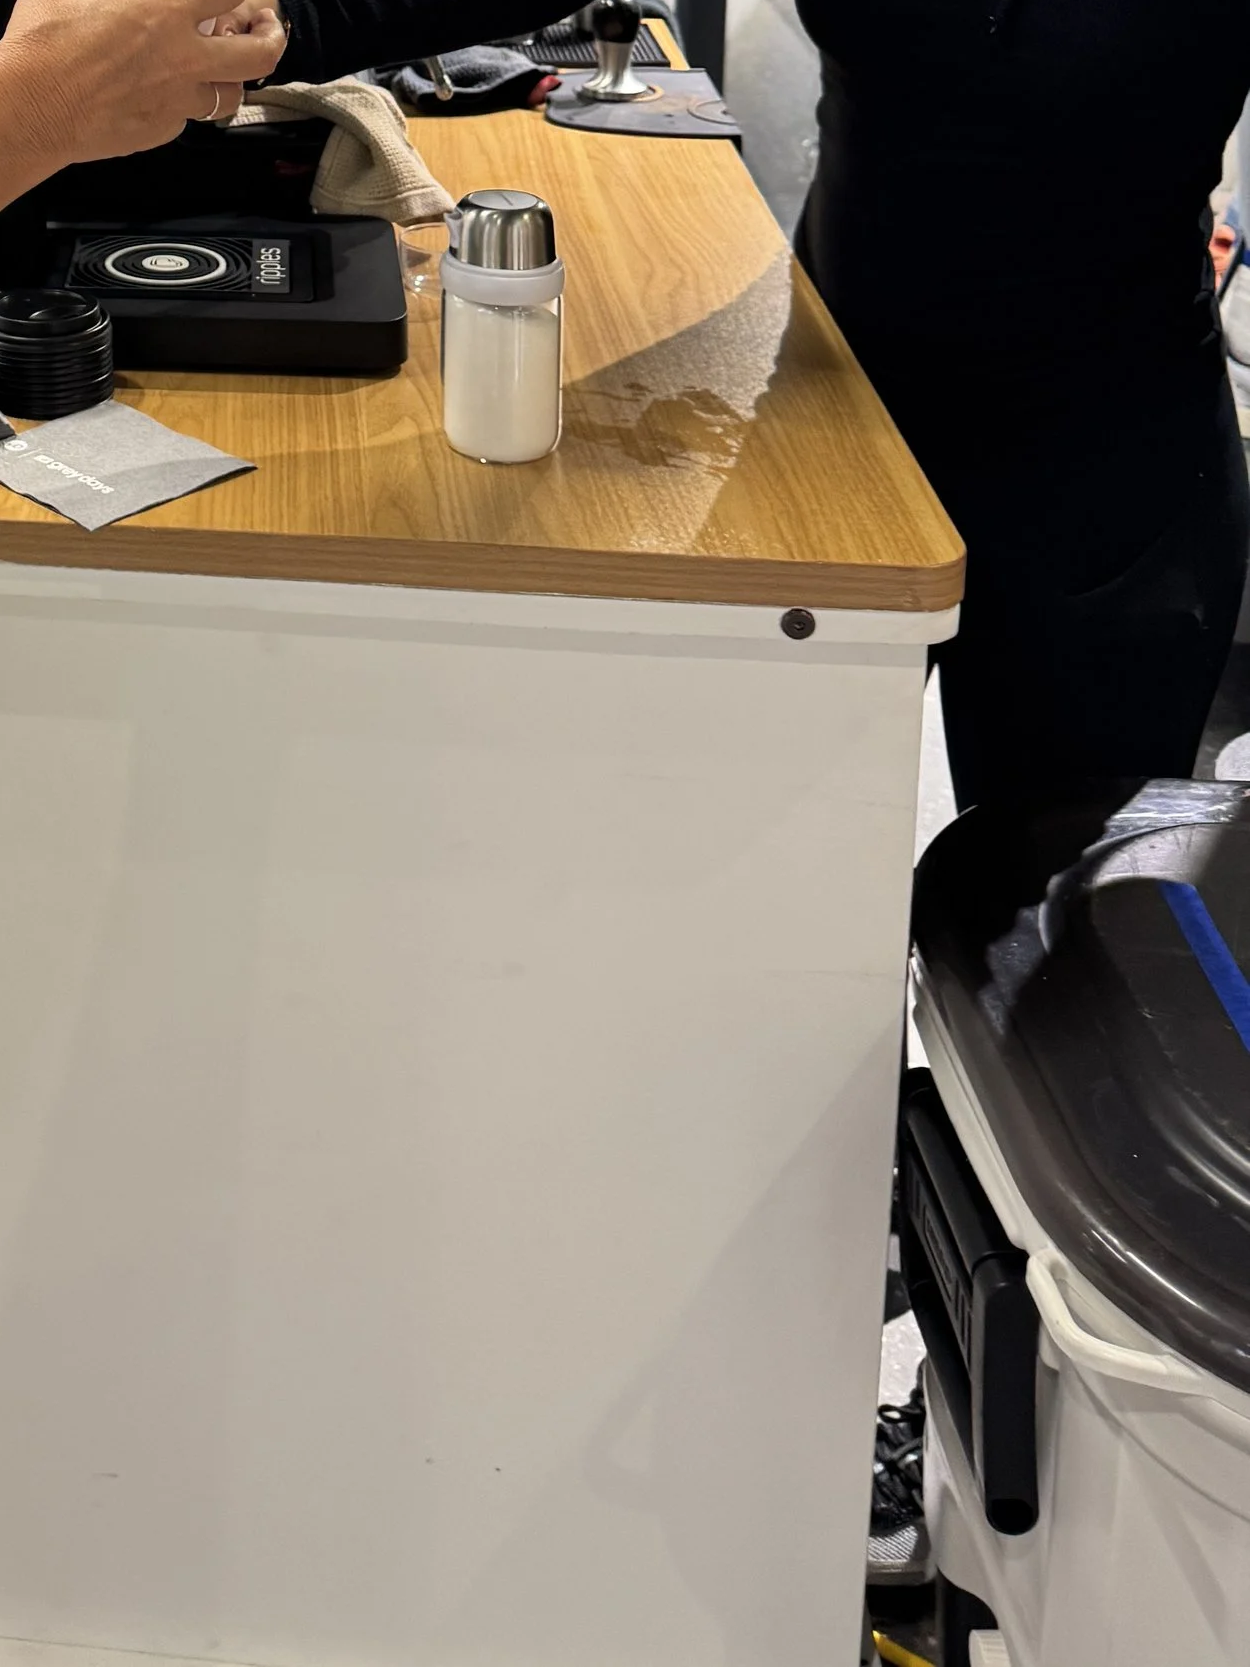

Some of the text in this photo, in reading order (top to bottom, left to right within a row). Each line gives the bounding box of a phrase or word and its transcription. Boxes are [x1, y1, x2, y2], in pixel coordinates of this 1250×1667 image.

[256, 246, 286, 285] ripples
[46, 461, 115, 494] grey days
